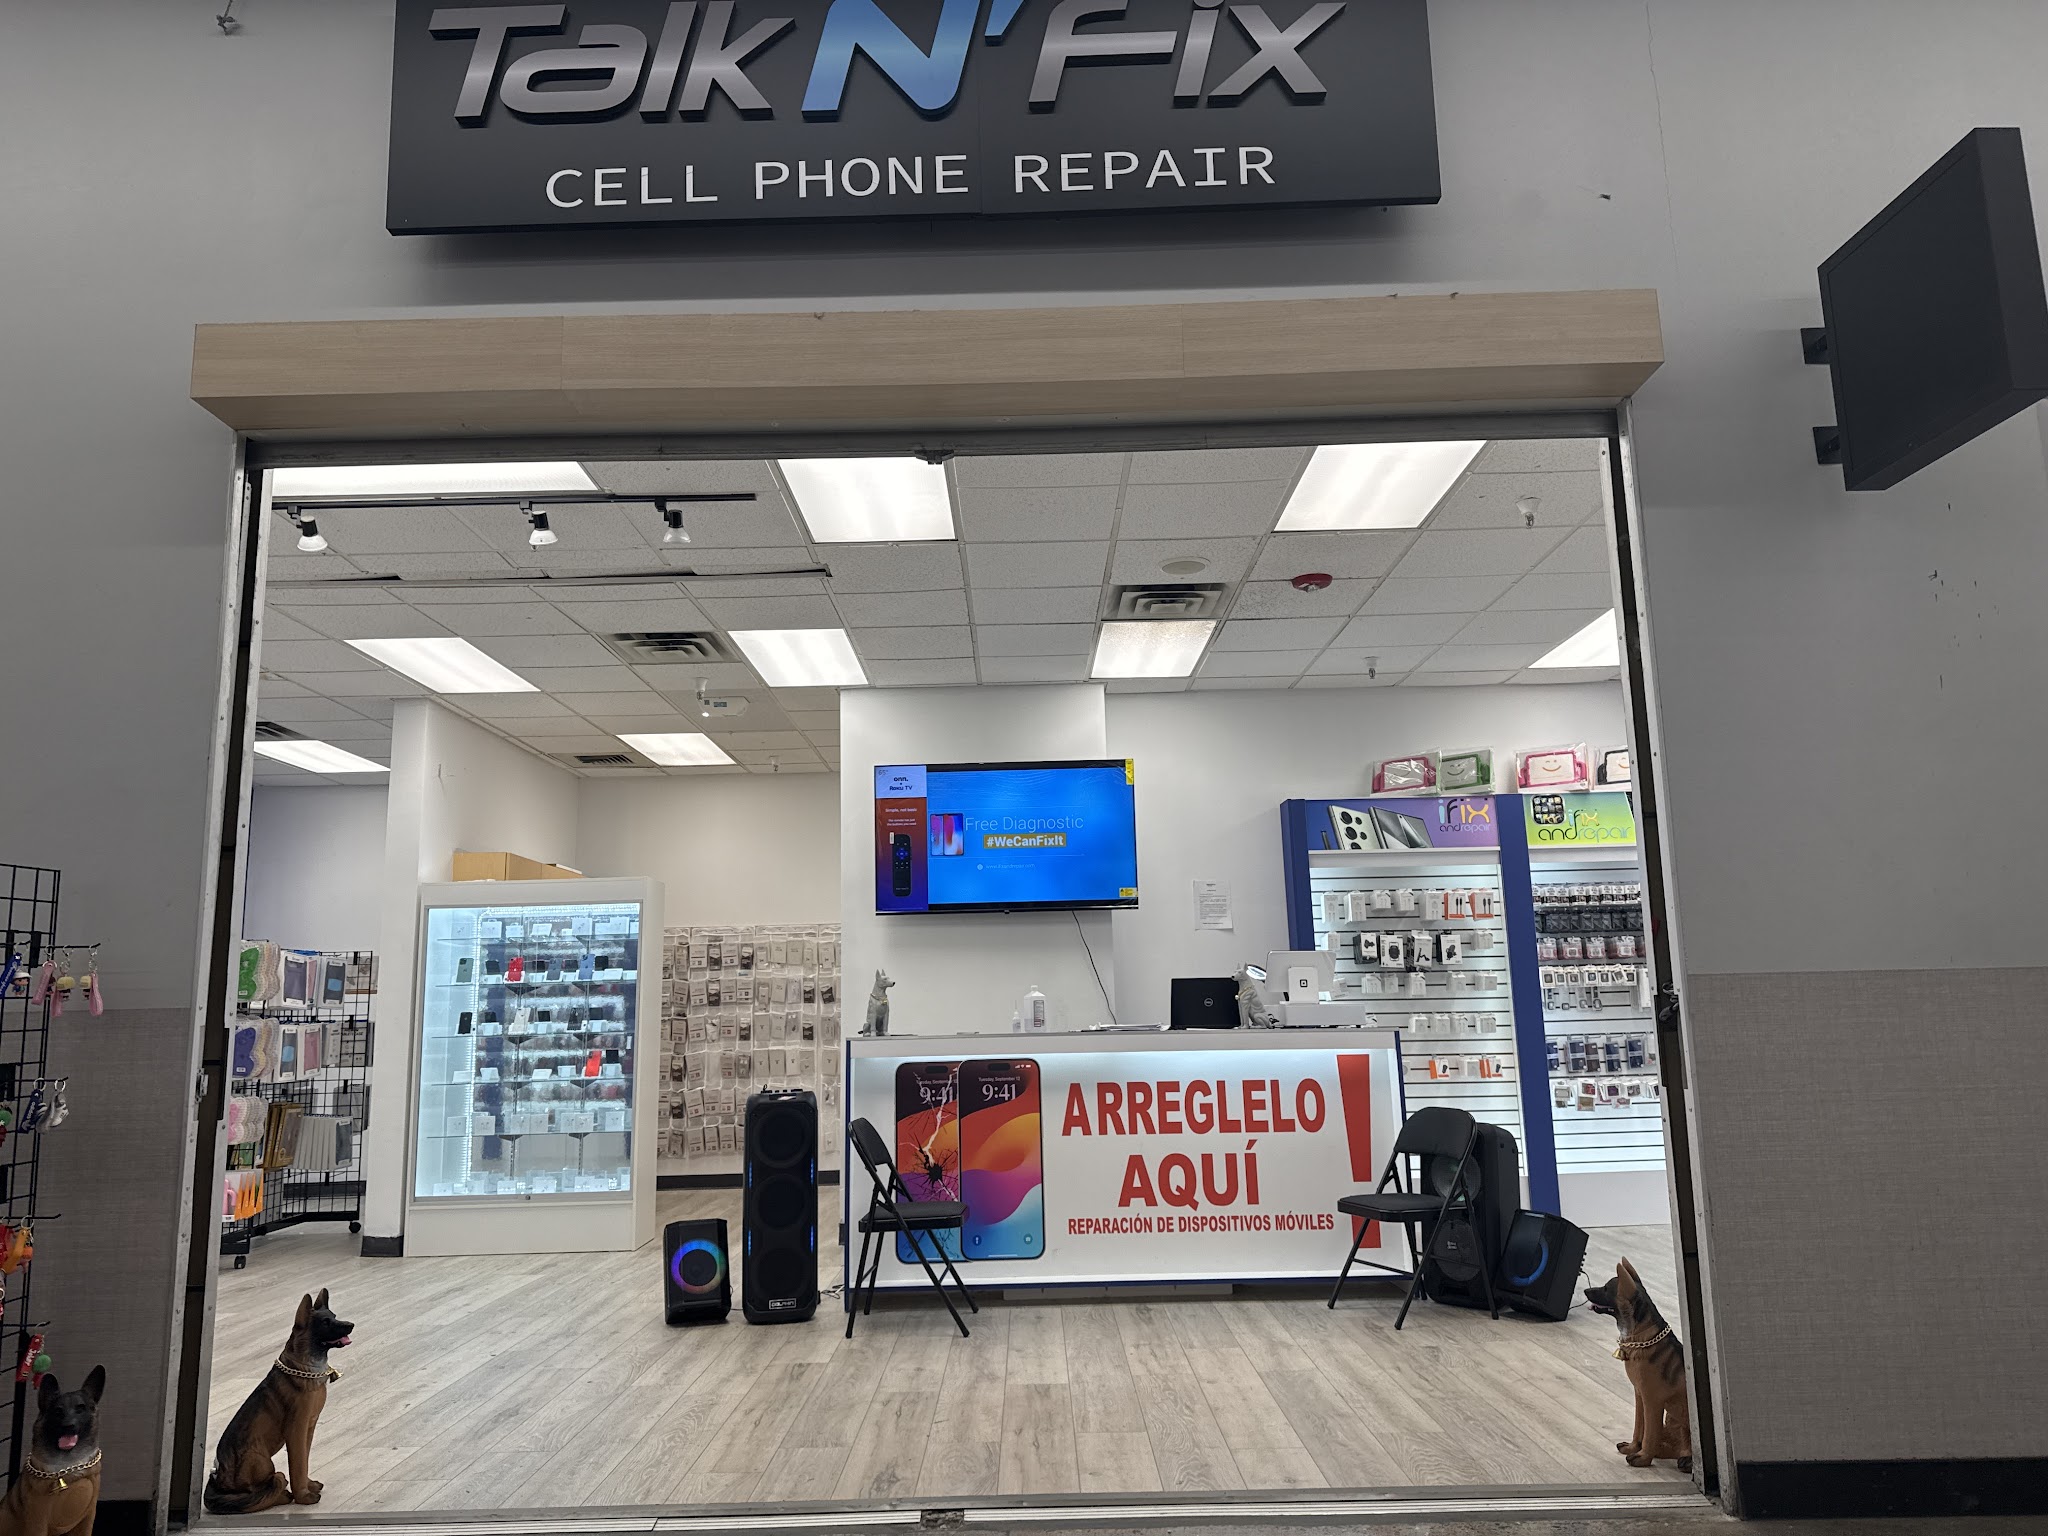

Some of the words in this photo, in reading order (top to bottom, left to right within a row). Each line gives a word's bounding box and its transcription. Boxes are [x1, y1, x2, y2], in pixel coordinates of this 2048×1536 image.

[428, 0, 796, 125] Talk
[1028, 0, 1348, 112] Fix
[545, 165, 718, 208] CELL
[754, 153, 969, 200] PHONE
[1013, 146, 1276, 193] REPAIR
[965, 817, 999, 831] Free
[1003, 814, 1084, 833] Diagnostic
[987, 834, 1064, 847] #WeCanFixIt
[982, 1083, 1016, 1102] 9:41
[1062, 1078, 1326, 1137] ARREGLELO
[1118, 1139, 1260, 1211] AQUÍ
[1068, 1213, 1152, 1236] REPARACIÓN
[1156, 1216, 1174, 1233] DE
[1178, 1214, 1272, 1233] DISPOSITIVOS
[1274, 1210, 1335, 1232] MÓVILES
